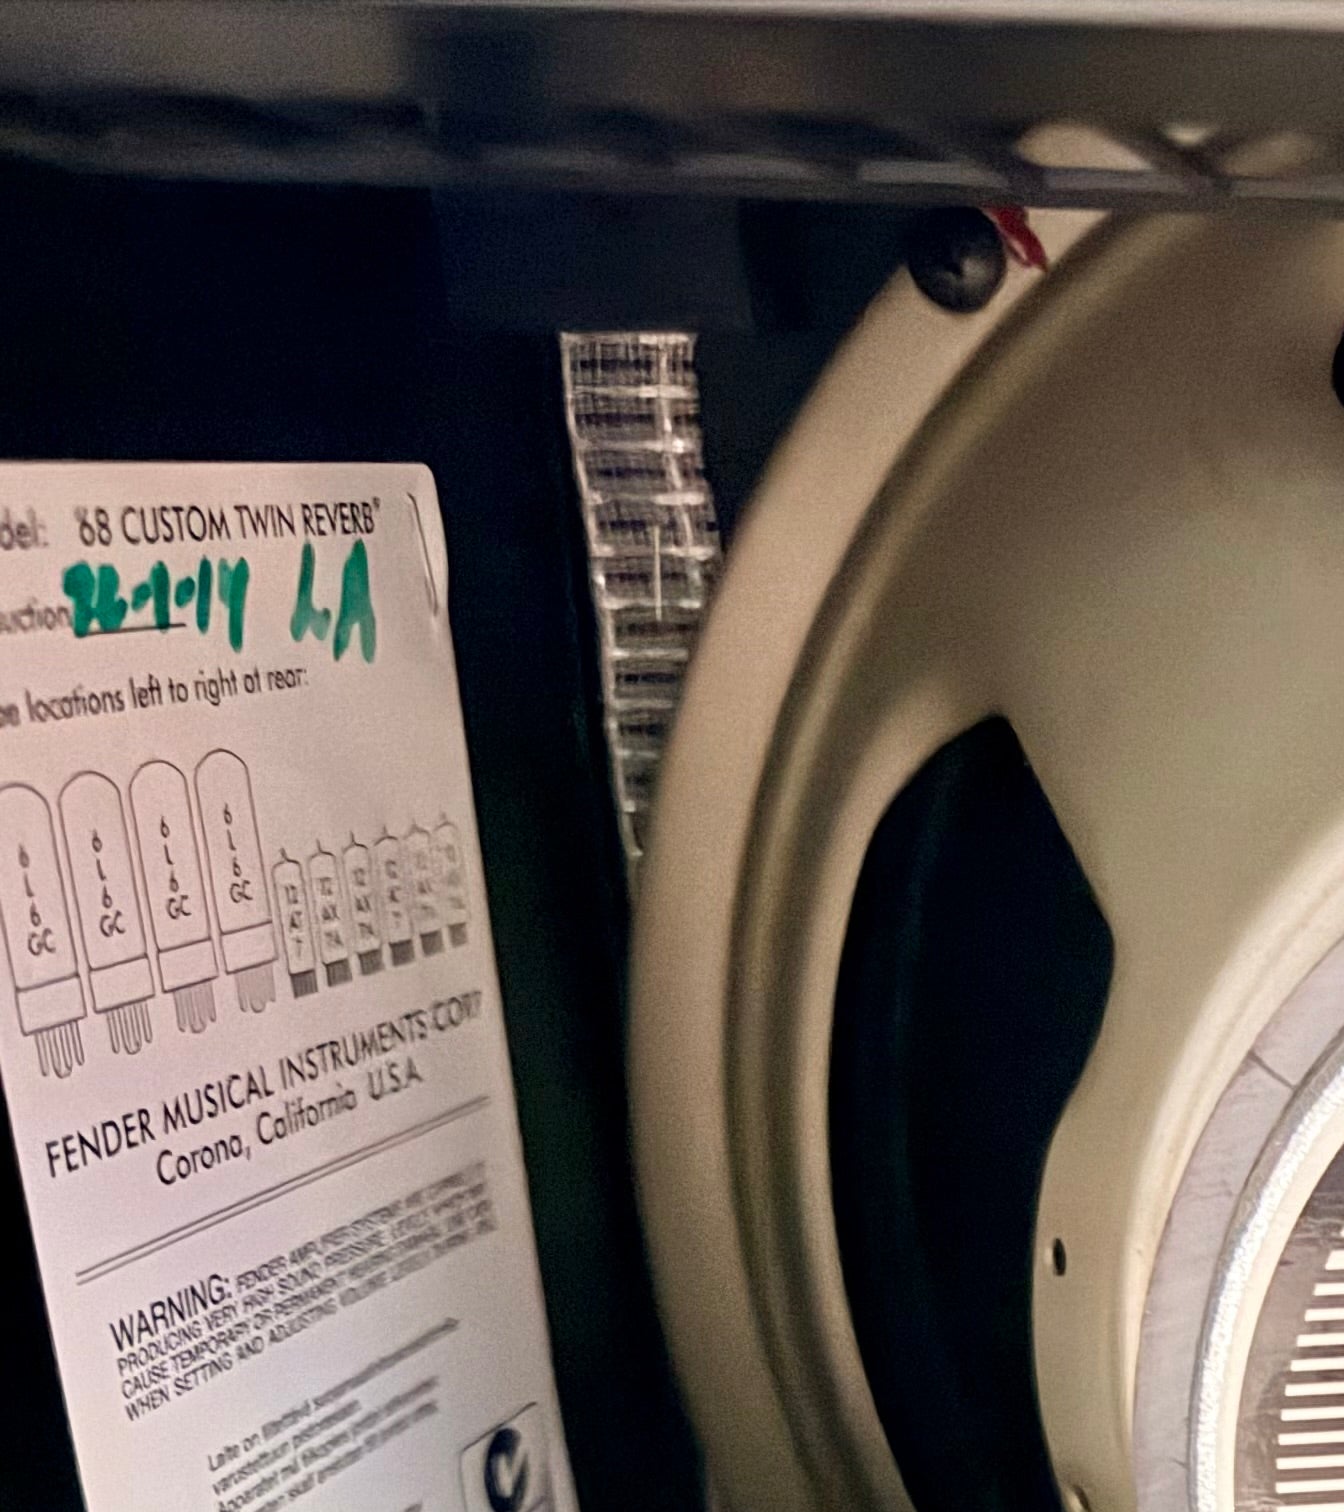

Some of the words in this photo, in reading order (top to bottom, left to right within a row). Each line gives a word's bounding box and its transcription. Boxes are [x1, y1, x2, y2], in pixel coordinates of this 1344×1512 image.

[0, 507, 49, 550] del:
[120, 504, 231, 545] CUSTOM
[233, 503, 297, 540] TWIN
[25, 684, 126, 723] locations
[129, 673, 164, 709] left
[168, 676, 189, 703] to
[194, 666, 239, 707] right
[243, 666, 262, 694] at
[45, 1107, 157, 1179] FENDER
[162, 1064, 275, 1135] MUSICAL
[279, 1008, 429, 1091] INSTRUMENTS
[156, 1134, 252, 1186] Corona,
[256, 1081, 358, 1145] California
[110, 1273, 233, 1353] WARNING:
[116, 1320, 202, 1377] PRODUCING
[173, 1351, 234, 1397] SETTING
[121, 1360, 171, 1400] CAUSE
